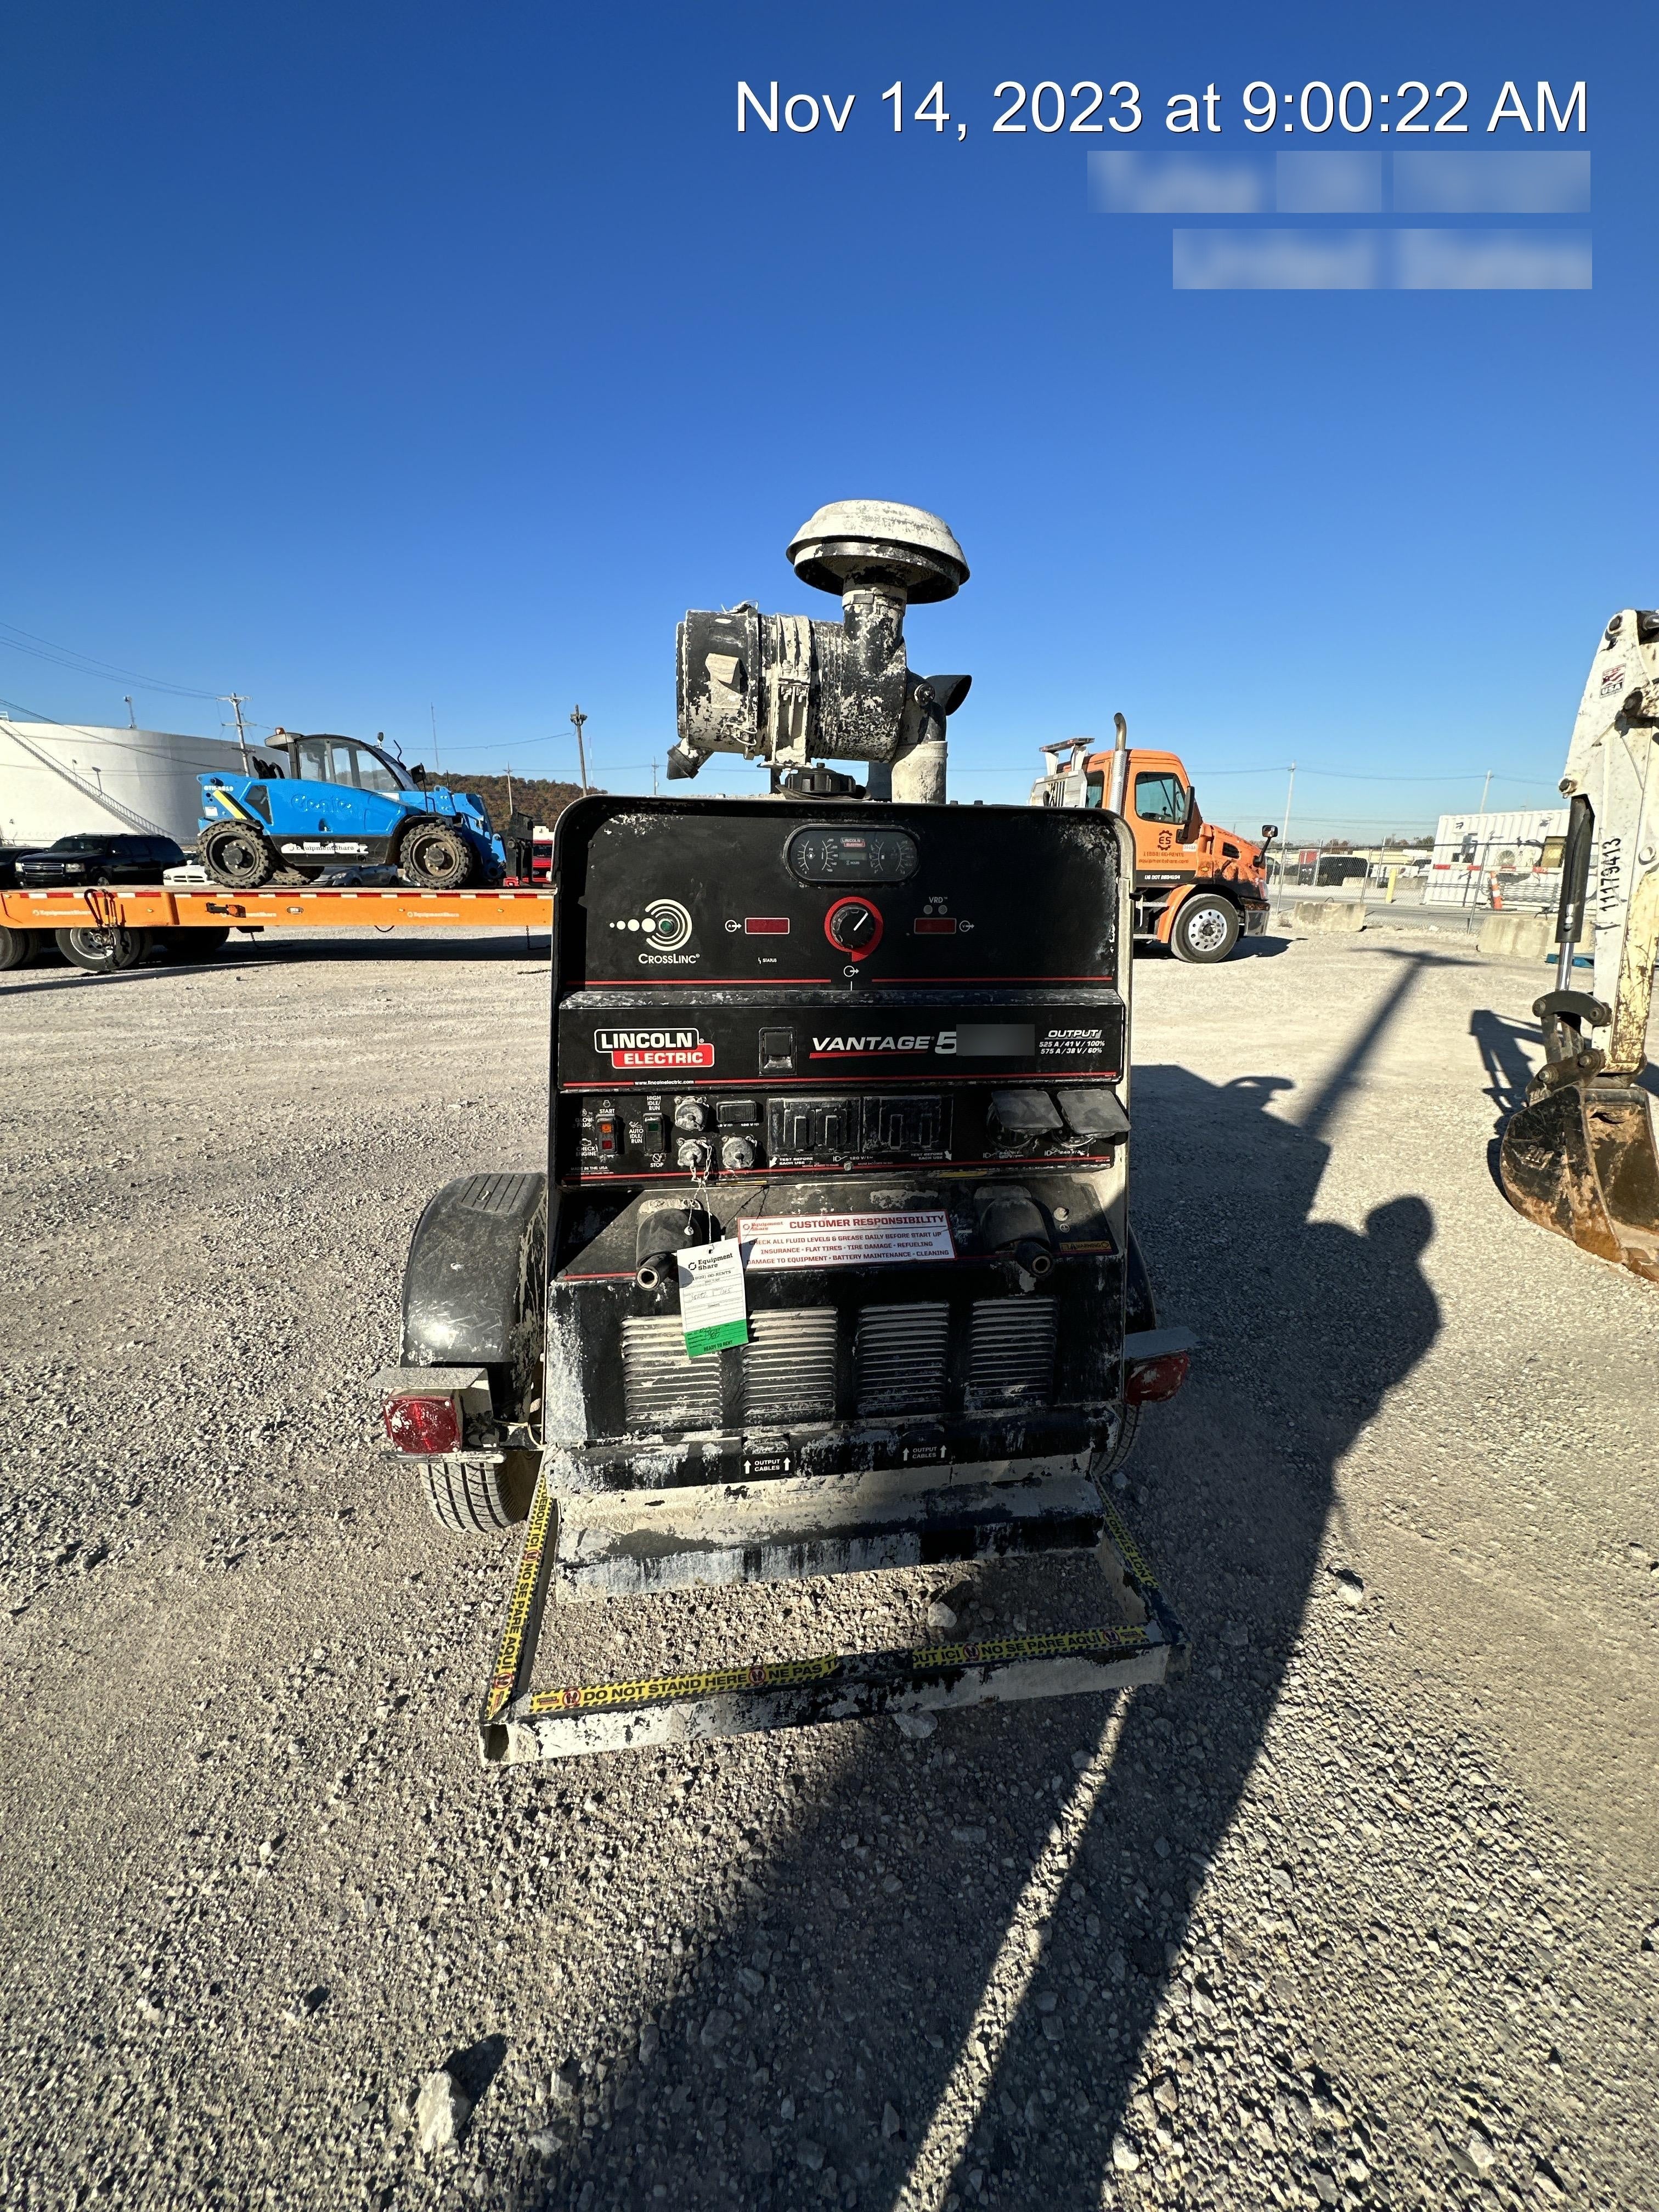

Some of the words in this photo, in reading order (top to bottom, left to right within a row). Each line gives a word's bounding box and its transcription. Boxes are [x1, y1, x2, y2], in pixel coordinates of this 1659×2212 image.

[1601, 682, 1622, 695] USA
[601, 1032, 692, 1049] LINCOLN
[624, 1052, 703, 1064] ELECTRIC
[789, 1219, 850, 1229] CUSTOMER
[853, 1215, 944, 1226] RESPONSIBILITY
[698, 1253, 733, 1265] Equipment
[704, 1344, 716, 1352] READY
[531, 1532, 540, 1548] ICI
[521, 1564, 534, 1581] NO
[518, 1583, 531, 1599] SE
[510, 1601, 528, 1634] PARE
[982, 1645, 1004, 1656] NO
[1007, 1643, 1026, 1652] SE
[1028, 1638, 1064, 1650] PARE
[941, 1650, 960, 1660] ICI
[769, 1668, 789, 1679] NE
[793, 1664, 823, 1677] PAS
[583, 1686, 608, 1701] DO
[612, 1683, 646, 1697] NOT
[648, 1677, 702, 1694] STAND
[705, 1673, 748, 1686] HERE
